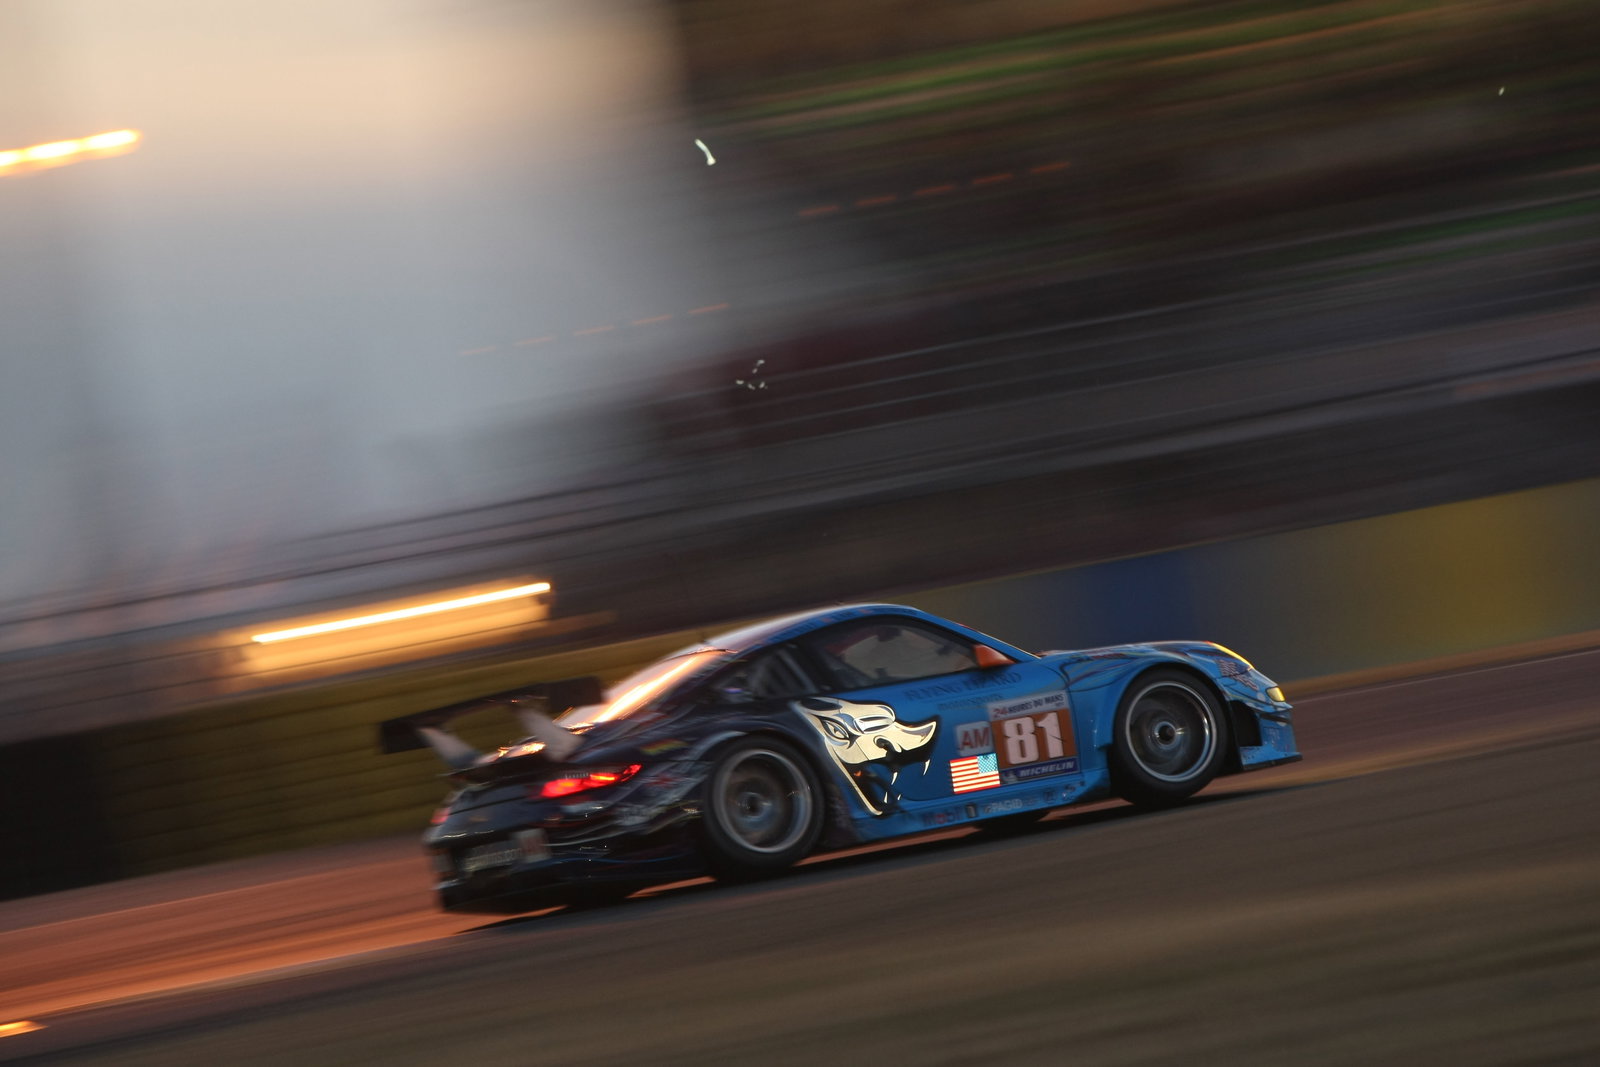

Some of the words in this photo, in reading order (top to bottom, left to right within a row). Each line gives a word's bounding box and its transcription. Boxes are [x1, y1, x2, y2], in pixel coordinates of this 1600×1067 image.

[1045, 693, 1064, 704] MANS
[959, 726, 990, 751] AM
[1004, 712, 1064, 764] 81
[1018, 761, 1074, 777] MICHELIN
